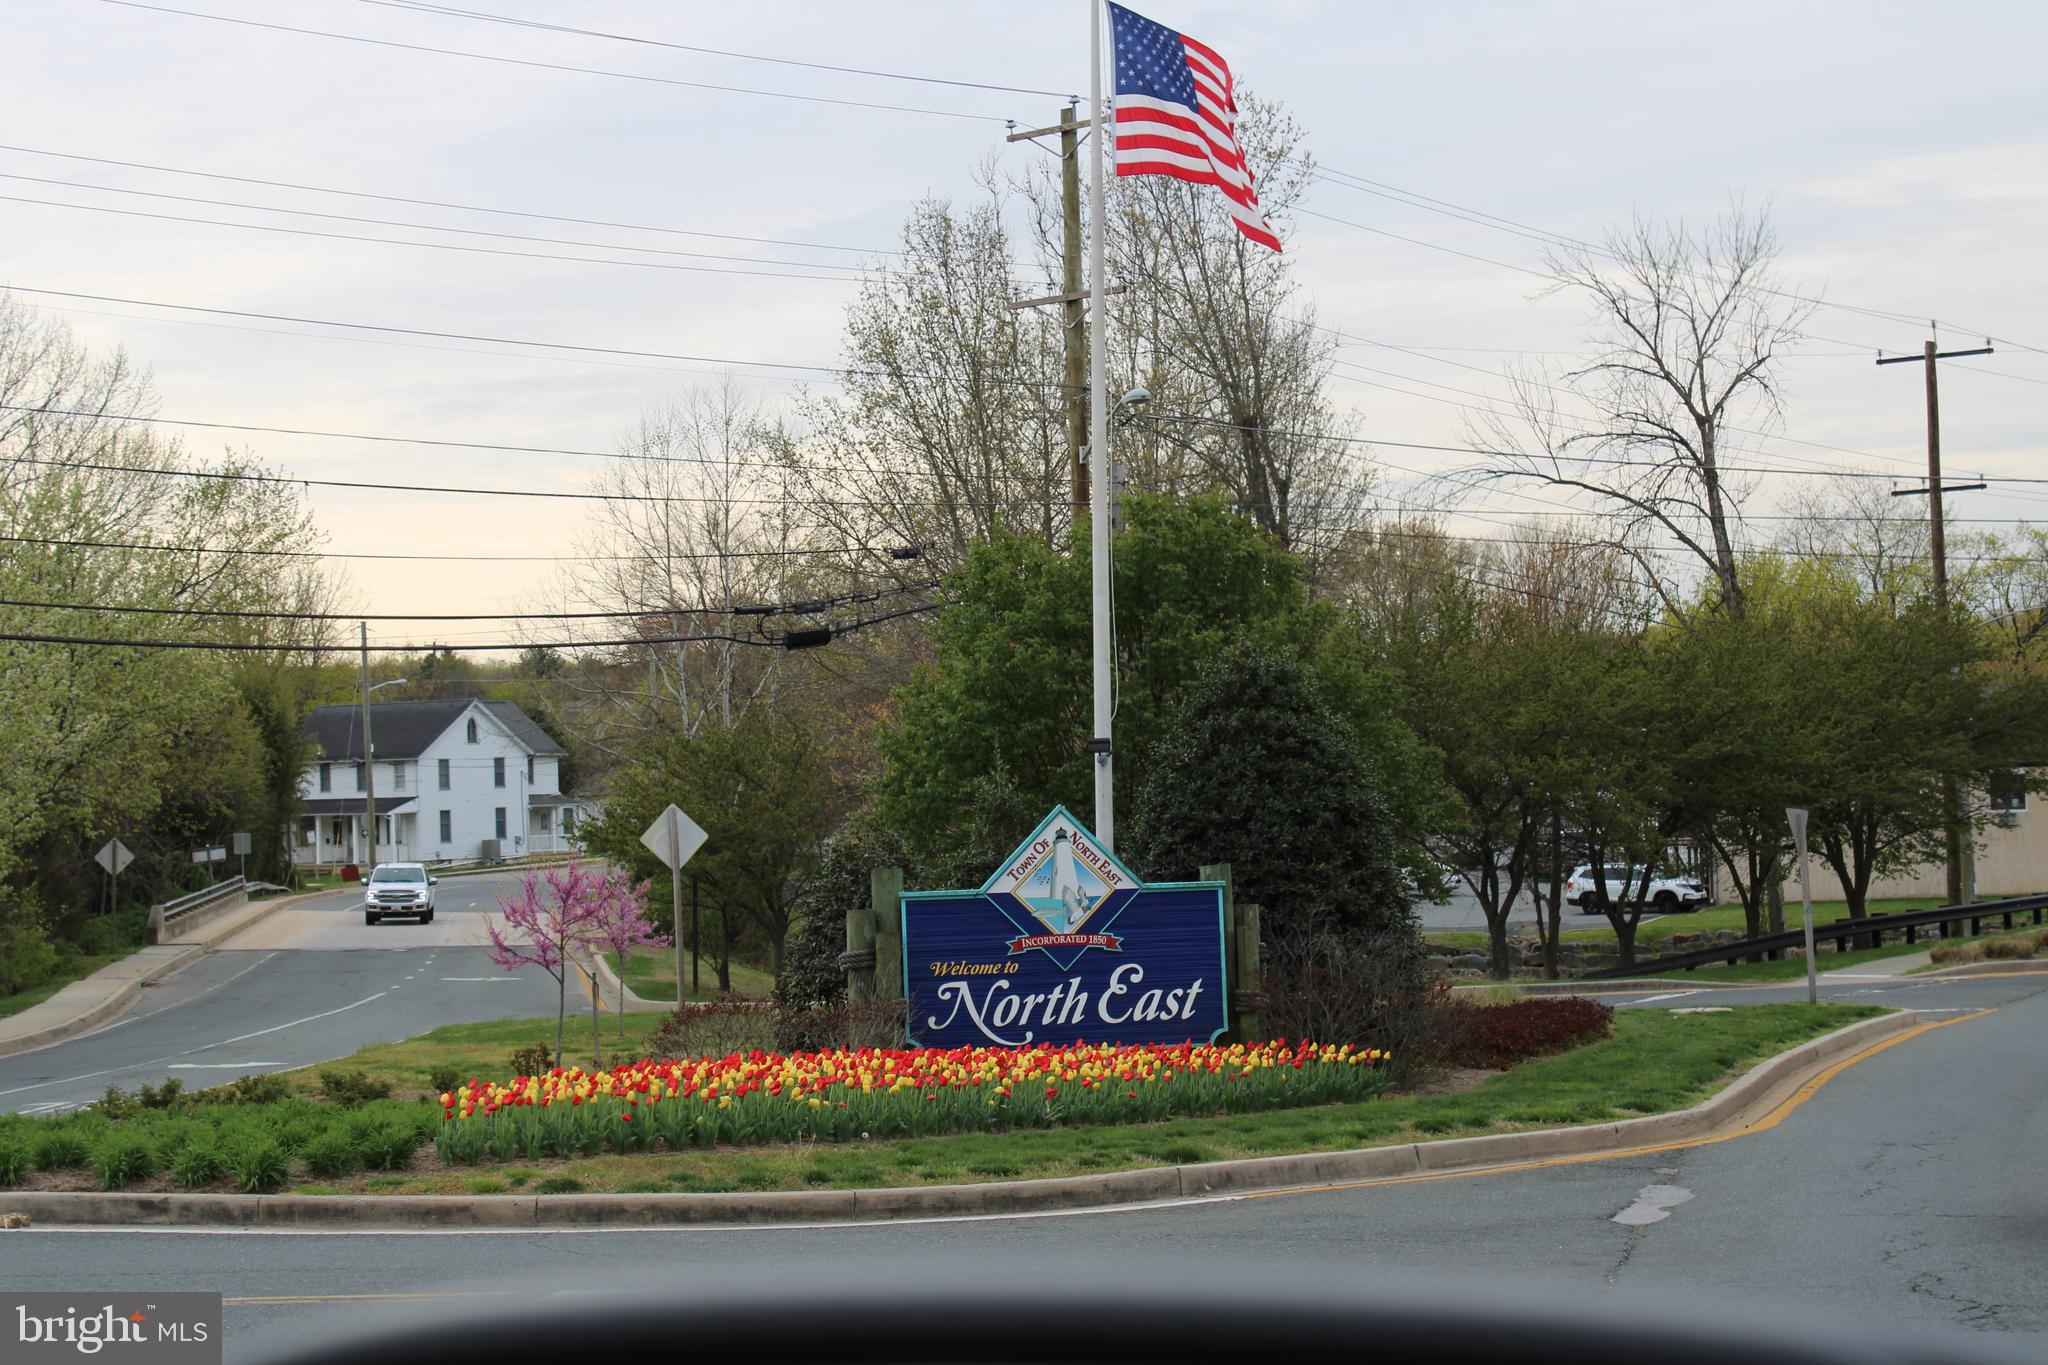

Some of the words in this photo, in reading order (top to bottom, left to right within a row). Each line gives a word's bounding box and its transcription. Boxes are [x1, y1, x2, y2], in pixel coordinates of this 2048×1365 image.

[1007, 852, 1038, 882] TOWN
[1069, 830, 1101, 866] NORTH
[1097, 859, 1124, 886] EAST
[1021, 935, 1087, 948] INCORPORATED
[1089, 933, 1108, 945] 1850
[929, 961, 1002, 977] Welcome
[1004, 961, 1020, 975] to
[927, 976, 1090, 1046] North
[1097, 963, 1205, 1025] East
